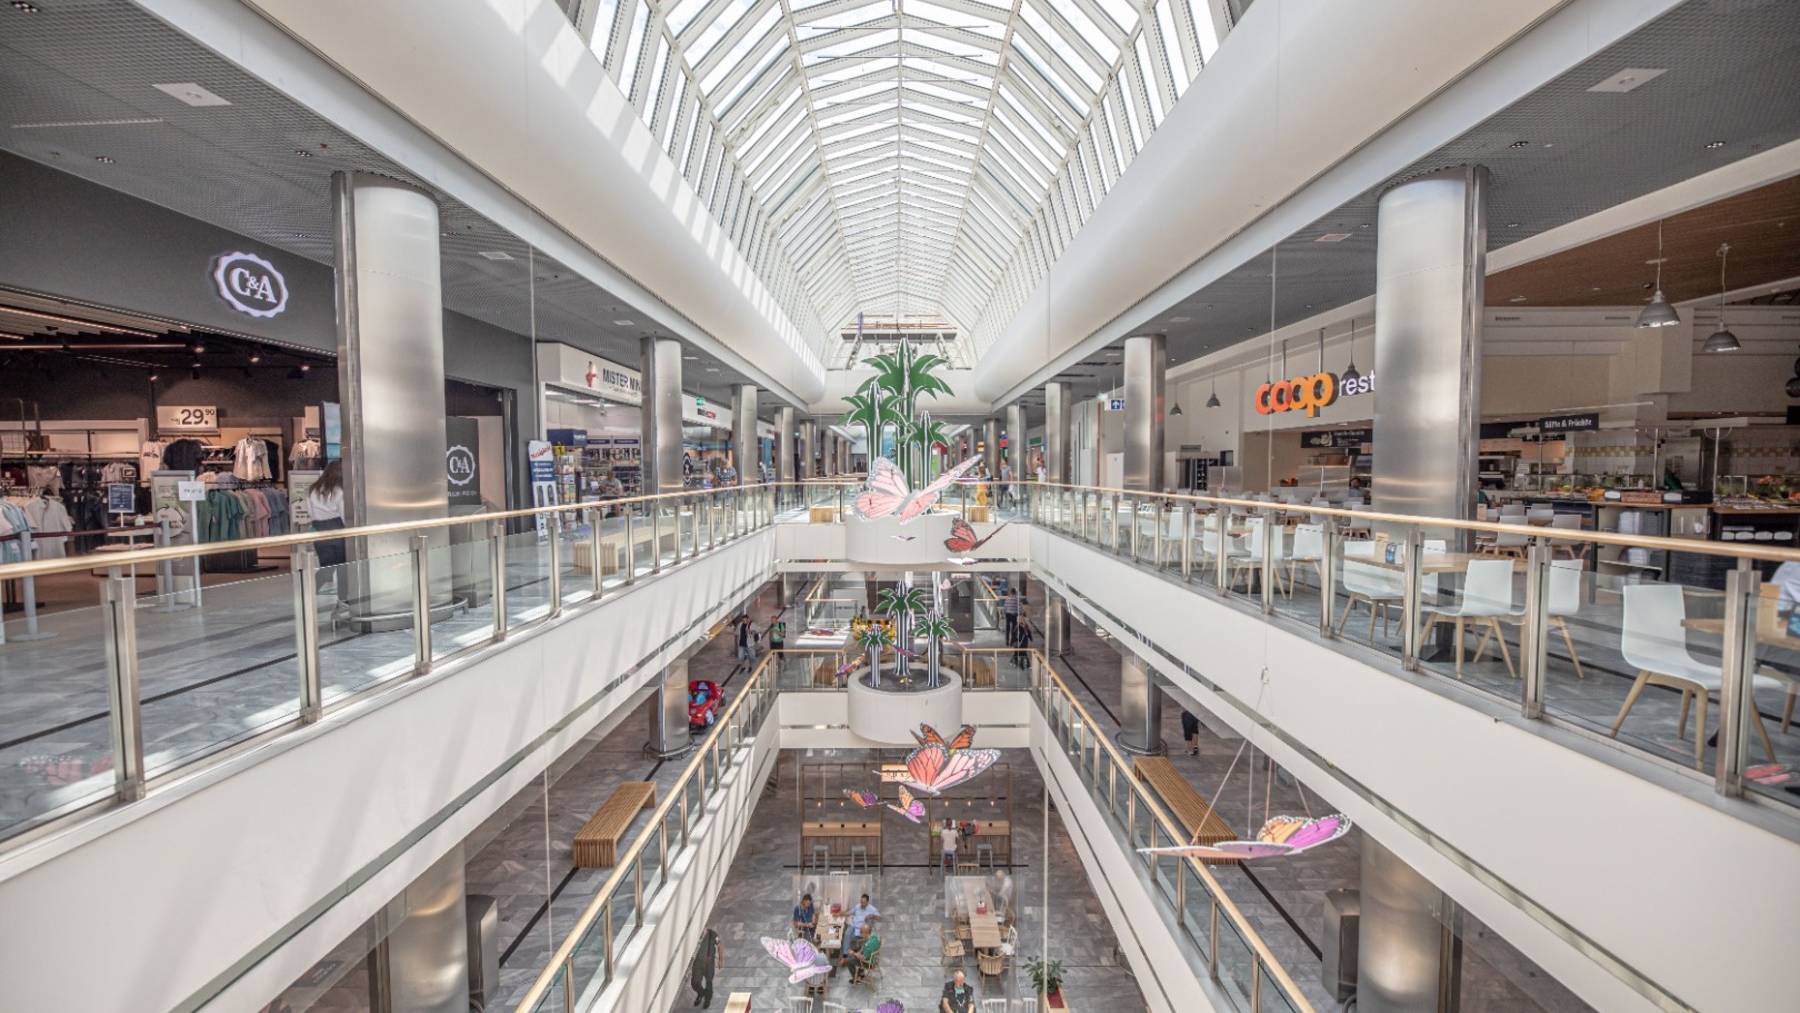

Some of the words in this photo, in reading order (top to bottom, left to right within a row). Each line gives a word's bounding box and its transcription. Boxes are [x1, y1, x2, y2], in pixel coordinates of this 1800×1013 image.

[229, 267, 278, 304] C&A
[602, 367, 629, 388] MISTER
[1254, 371, 1337, 418] coop
[1338, 369, 1376, 397] rest
